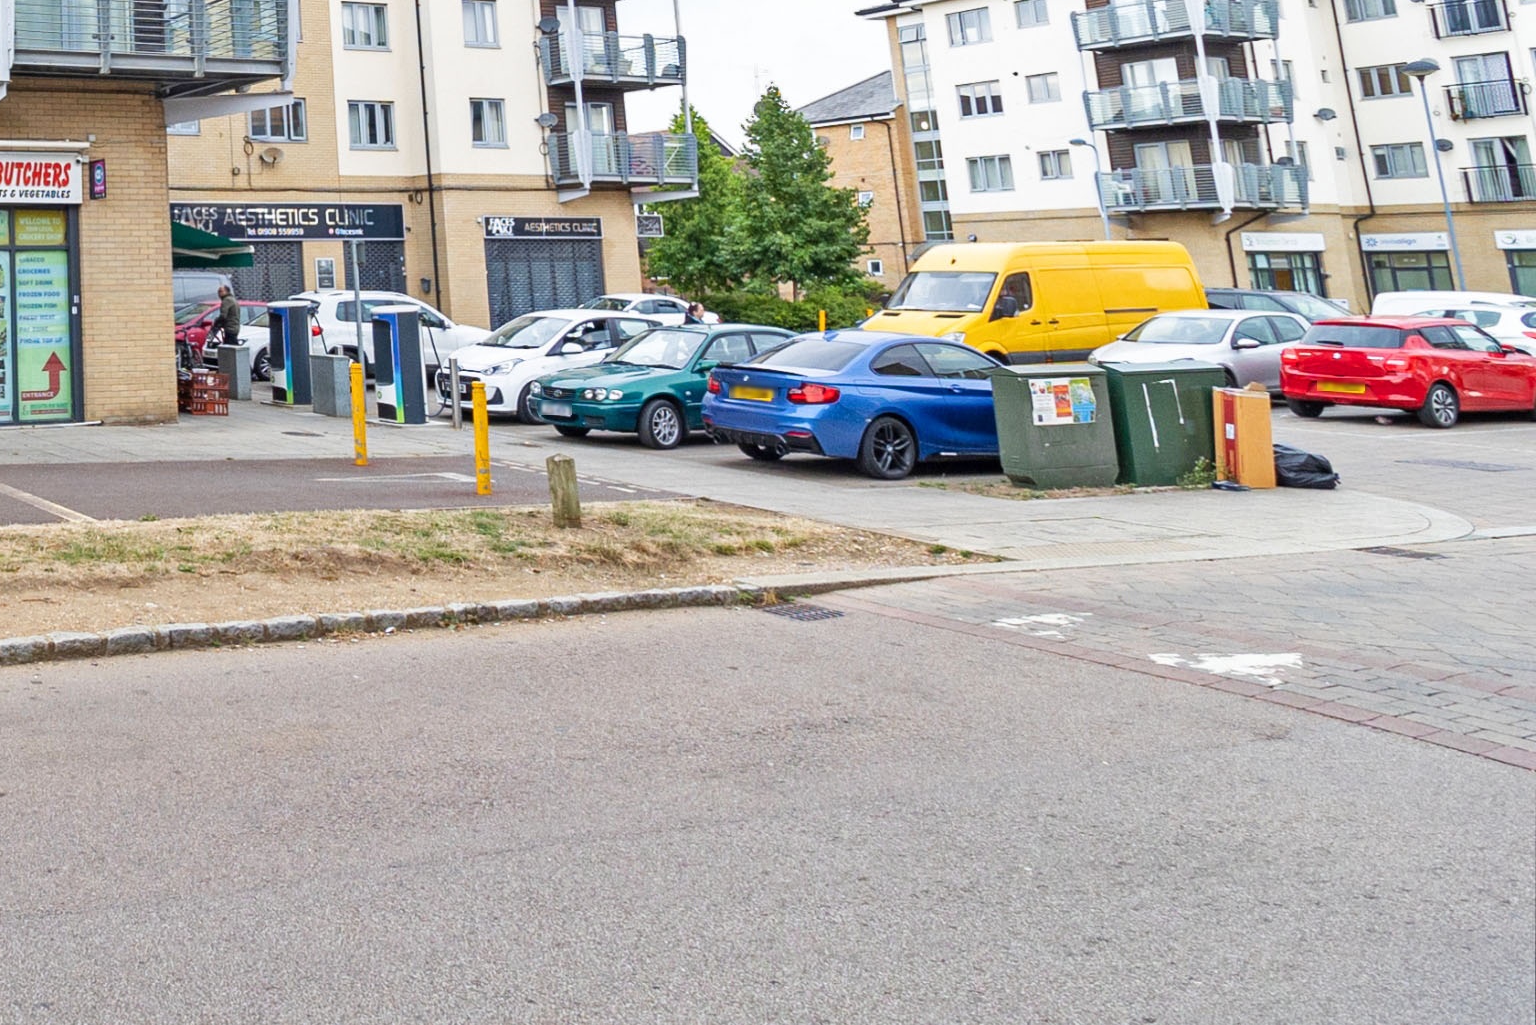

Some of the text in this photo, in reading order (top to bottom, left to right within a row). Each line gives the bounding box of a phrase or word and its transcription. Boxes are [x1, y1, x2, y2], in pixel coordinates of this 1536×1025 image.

[10, 189, 16, 198] &
[19, 190, 71, 198] VEGETABLES
[224, 208, 374, 226] AESTHETICS CLINIC
[524, 222, 598, 232] AESTHETICS CLINIC
